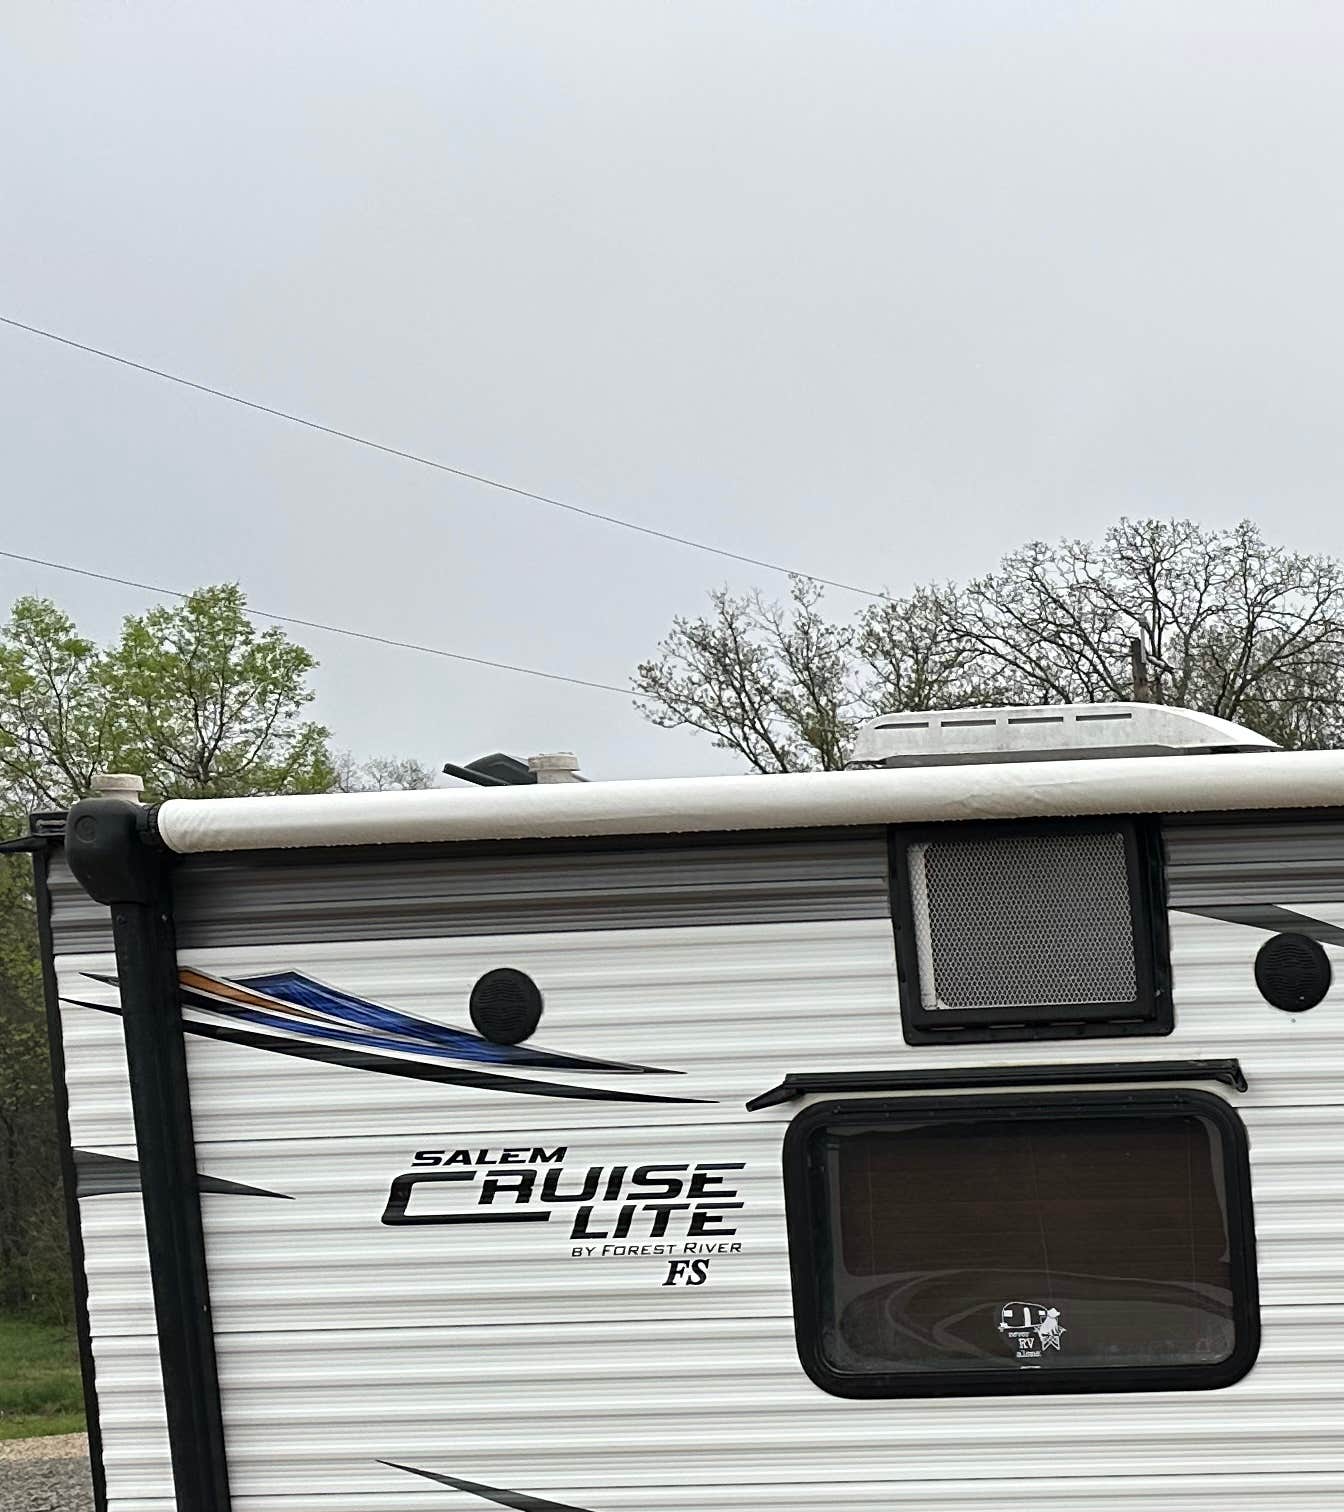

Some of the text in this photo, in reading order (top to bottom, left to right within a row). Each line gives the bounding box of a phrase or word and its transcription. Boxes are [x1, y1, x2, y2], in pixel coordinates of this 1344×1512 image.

[411, 1146, 568, 1167] SALEM
[381, 1162, 747, 1226] CRUISE
[570, 1202, 745, 1240] LITE
[571, 1241, 742, 1257] BY FOREST RIVER
[662, 1258, 710, 1286] FS
[1018, 1337, 1035, 1349] RV
